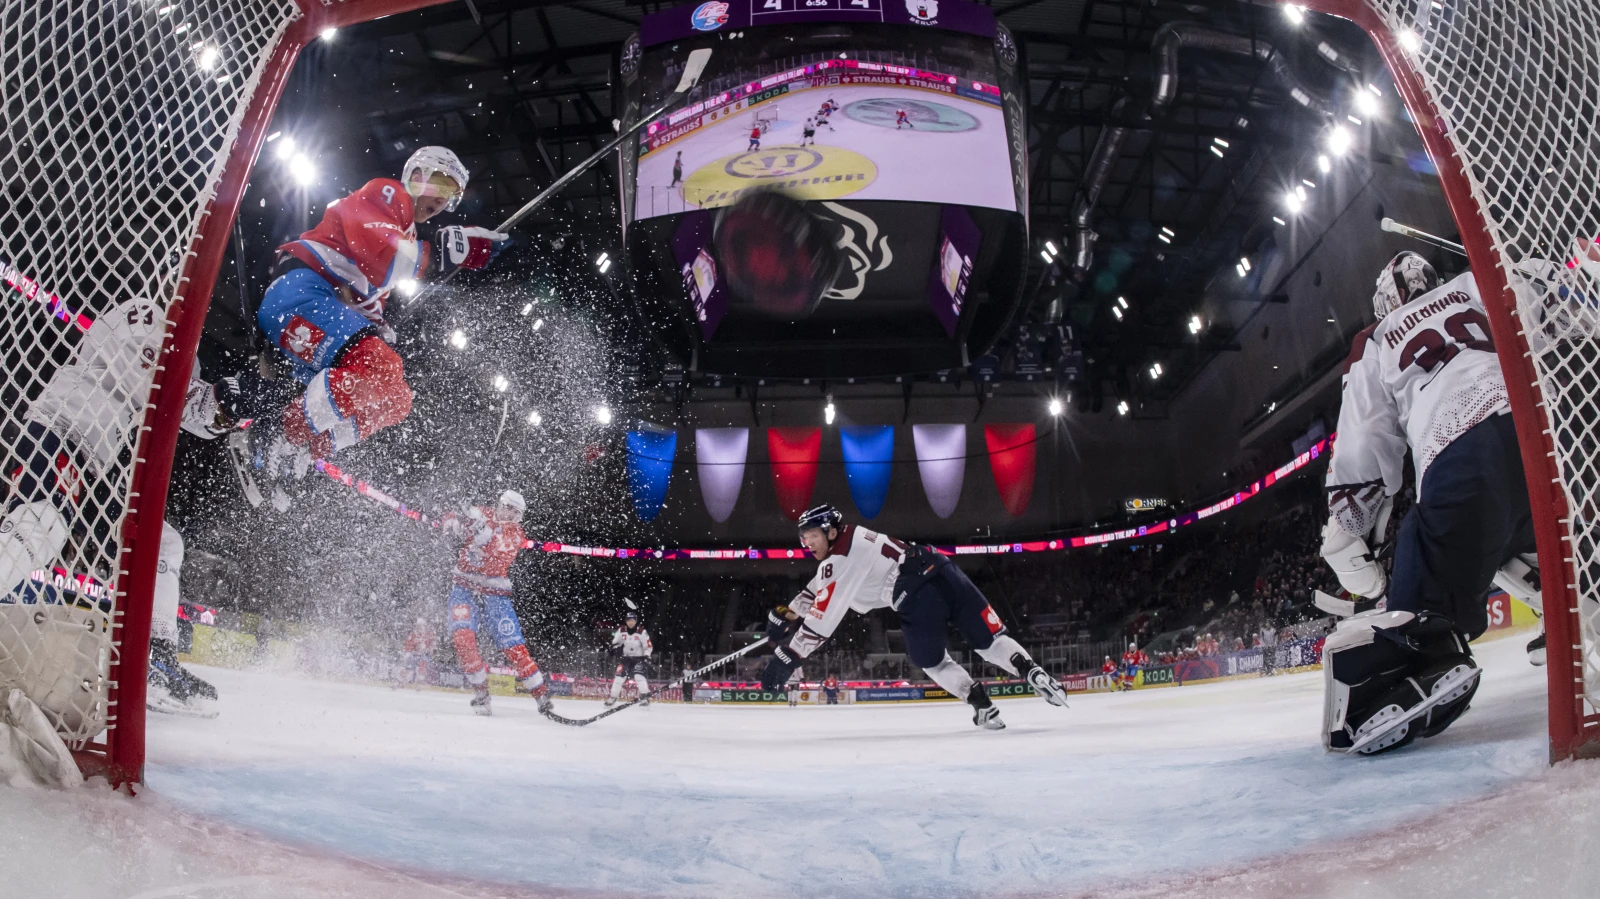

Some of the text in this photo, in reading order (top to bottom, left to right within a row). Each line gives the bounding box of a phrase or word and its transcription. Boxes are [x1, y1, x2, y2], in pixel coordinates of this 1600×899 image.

[909, 16, 938, 26] BERLIN
[852, 75, 897, 84] STRAUSS
[909, 79, 952, 93] STRAUSS
[660, 117, 700, 145] STRAUSS
[381, 184, 396, 205] 9
[1198, 503, 1221, 519] DOWNLOAD
[1084, 528, 1137, 545] DOWNLOAD THE APP
[690, 550, 747, 558] DOWNLOAD THE APP
[955, 545, 1010, 554] DOWNLOAD THE APP
[821, 563, 834, 580] 18
[1145, 671, 1174, 682] KODA
[990, 685, 1037, 695] SKOD
[1062, 679, 1086, 691] TRAUSS
